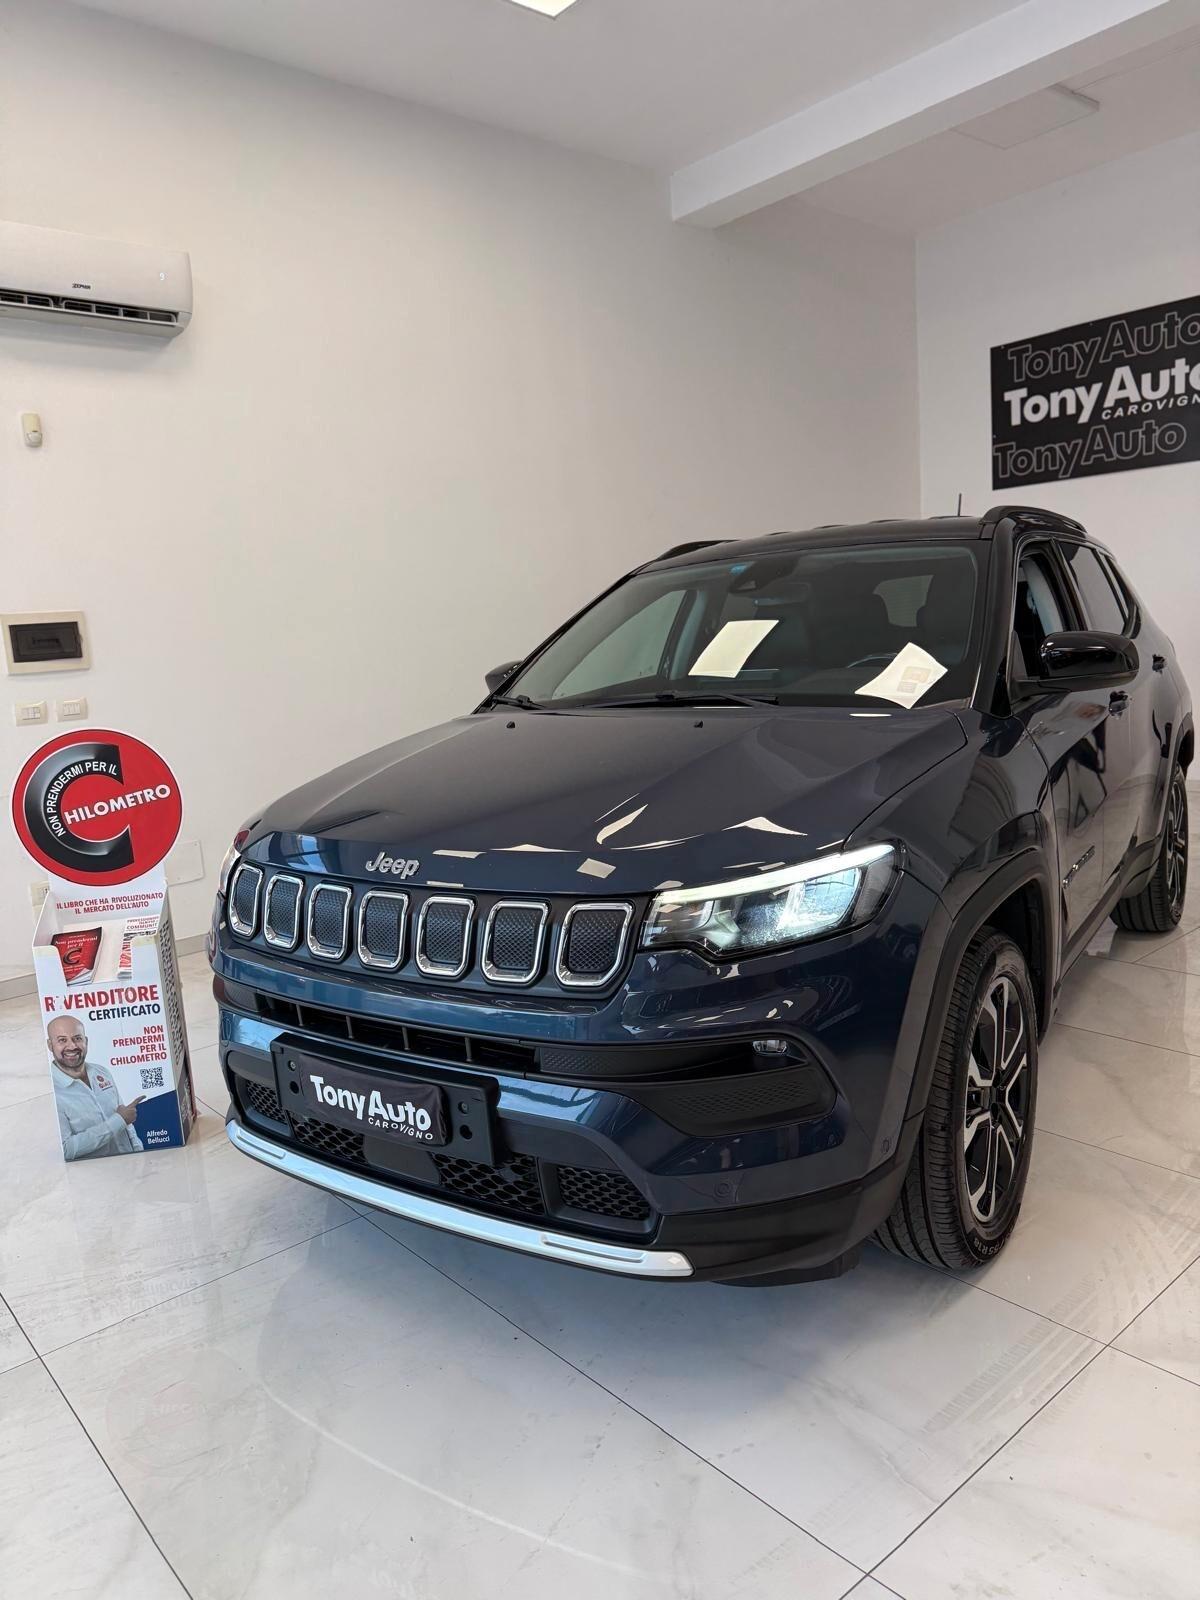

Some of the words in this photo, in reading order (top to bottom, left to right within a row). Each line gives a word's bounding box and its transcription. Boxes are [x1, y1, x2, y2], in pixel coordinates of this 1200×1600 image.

[1008, 312, 1200, 382] TonyAuto
[993, 420, 1186, 478] TonyAuto
[85, 761, 107, 772] PER
[108, 763, 118, 776] IL
[47, 763, 84, 812] PRENDERMI
[48, 815, 66, 837] NON
[365, 851, 420, 880] Jeep
[56, 902, 63, 910] IL
[64, 900, 84, 909] LIBRO
[111, 892, 163, 904] RIVOLUZIONATO
[84, 904, 115, 914] MERCATO
[116, 901, 149, 911] DELL'AUTO
[44, 984, 160, 1012] RVENDITORE
[88, 1003, 161, 1021] CERTIFICATO
[143, 1025, 164, 1034] NON
[112, 1034, 165, 1047] PRENDERMI
[140, 1045, 156, 1053] PER
[110, 1052, 167, 1066] CHILOMETRO
[310, 1074, 432, 1131] TonyAuto
[147, 1129, 168, 1137] Alfredo
[368, 1117, 433, 1140] CAROVIGNO
[148, 1136, 170, 1144] Bellucci
